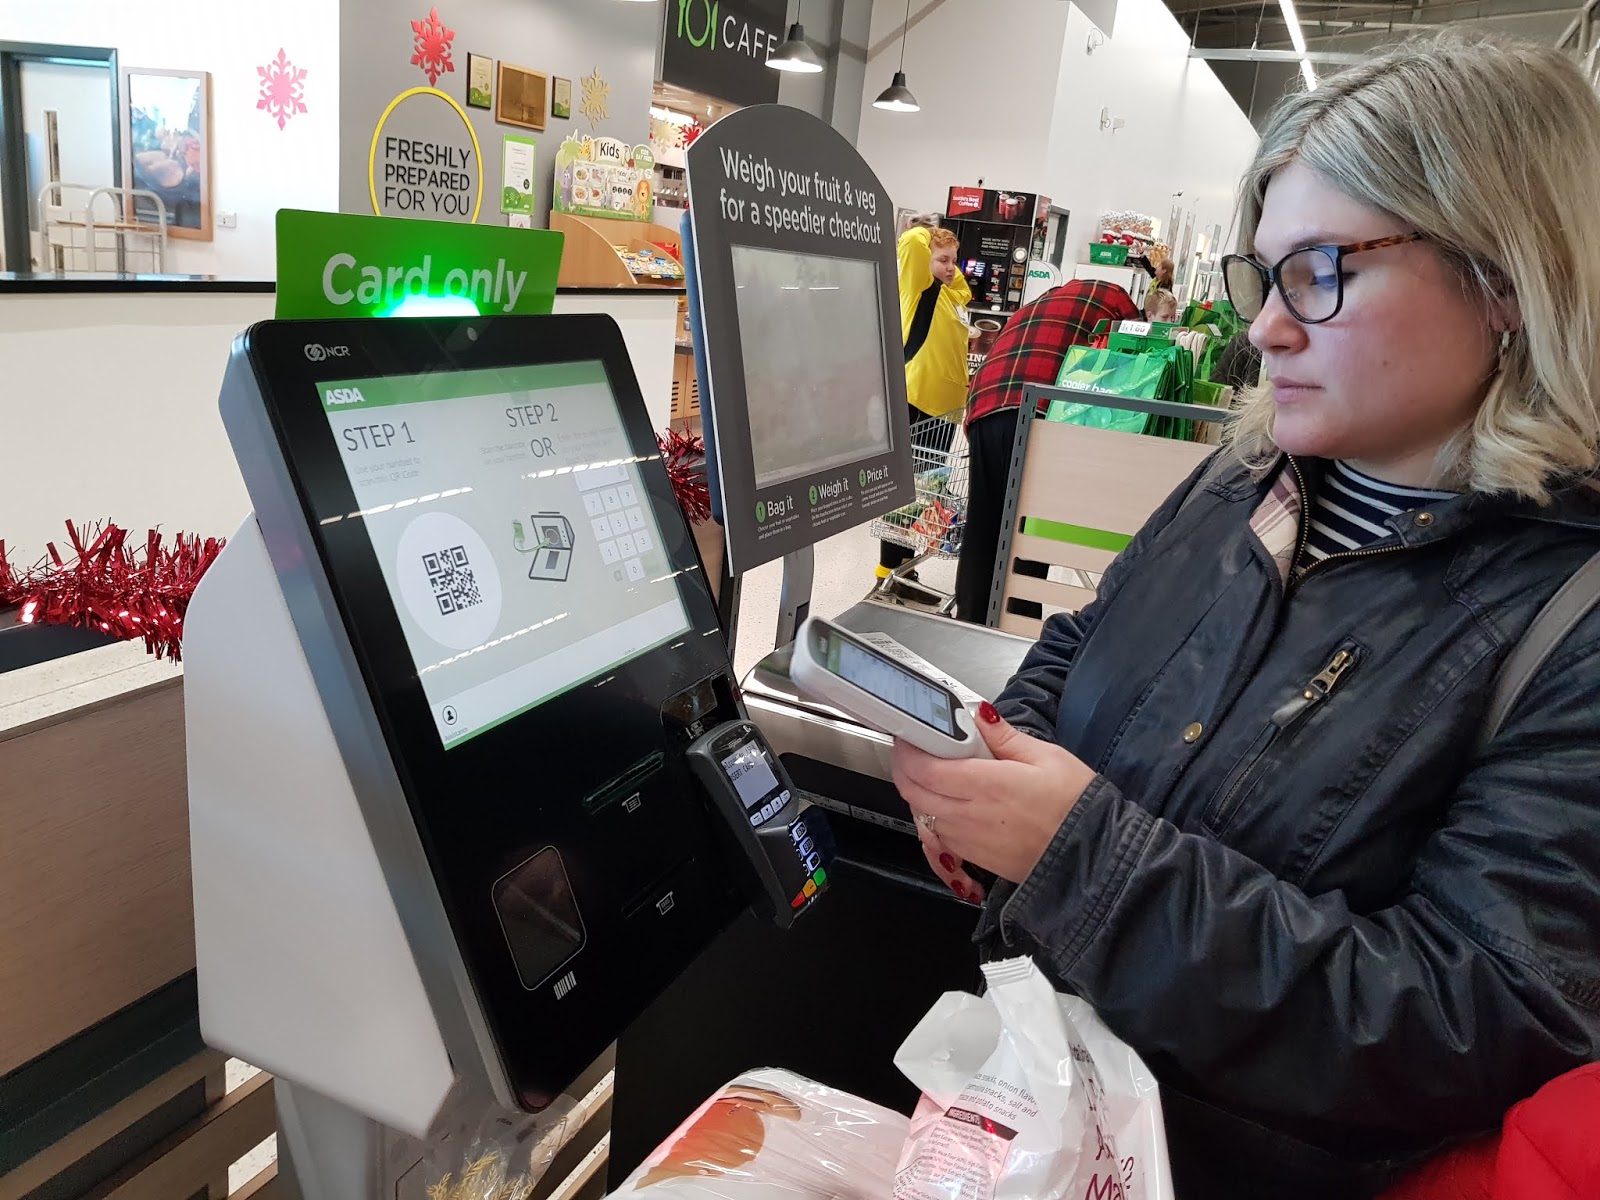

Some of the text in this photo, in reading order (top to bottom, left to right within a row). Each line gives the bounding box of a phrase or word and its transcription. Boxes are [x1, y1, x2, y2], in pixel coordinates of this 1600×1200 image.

[385, 136, 471, 169] FRESHLY
[600, 142, 620, 160] Kids
[385, 163, 470, 191] PREPARED
[719, 146, 876, 216] Weigh your fruit & veg
[384, 186, 470, 215] FOR YOU
[719, 187, 882, 244] for a speedier checkout
[322, 252, 528, 313] Card only
[1027, 269, 1050, 279] ASDA
[327, 344, 350, 357] NCR
[1061, 379, 1091, 391] cooler
[325, 387, 366, 406] ASDA
[506, 402, 559, 428] STEP 2
[343, 421, 416, 452] STEP 1
[530, 437, 557, 458] OR
[866, 468, 883, 483] Price
[882, 464, 889, 478] it
[818, 479, 843, 499] Weigh
[842, 477, 849, 491] it
[767, 500, 785, 517] Bag
[786, 495, 794, 511] it
[998, 1079, 1019, 1095] onion
[984, 1086, 1006, 1105] snacks,
[1008, 1098, 1023, 1109] salt
[1022, 1105, 1039, 1118] and
[993, 1105, 1018, 1121] snacks
